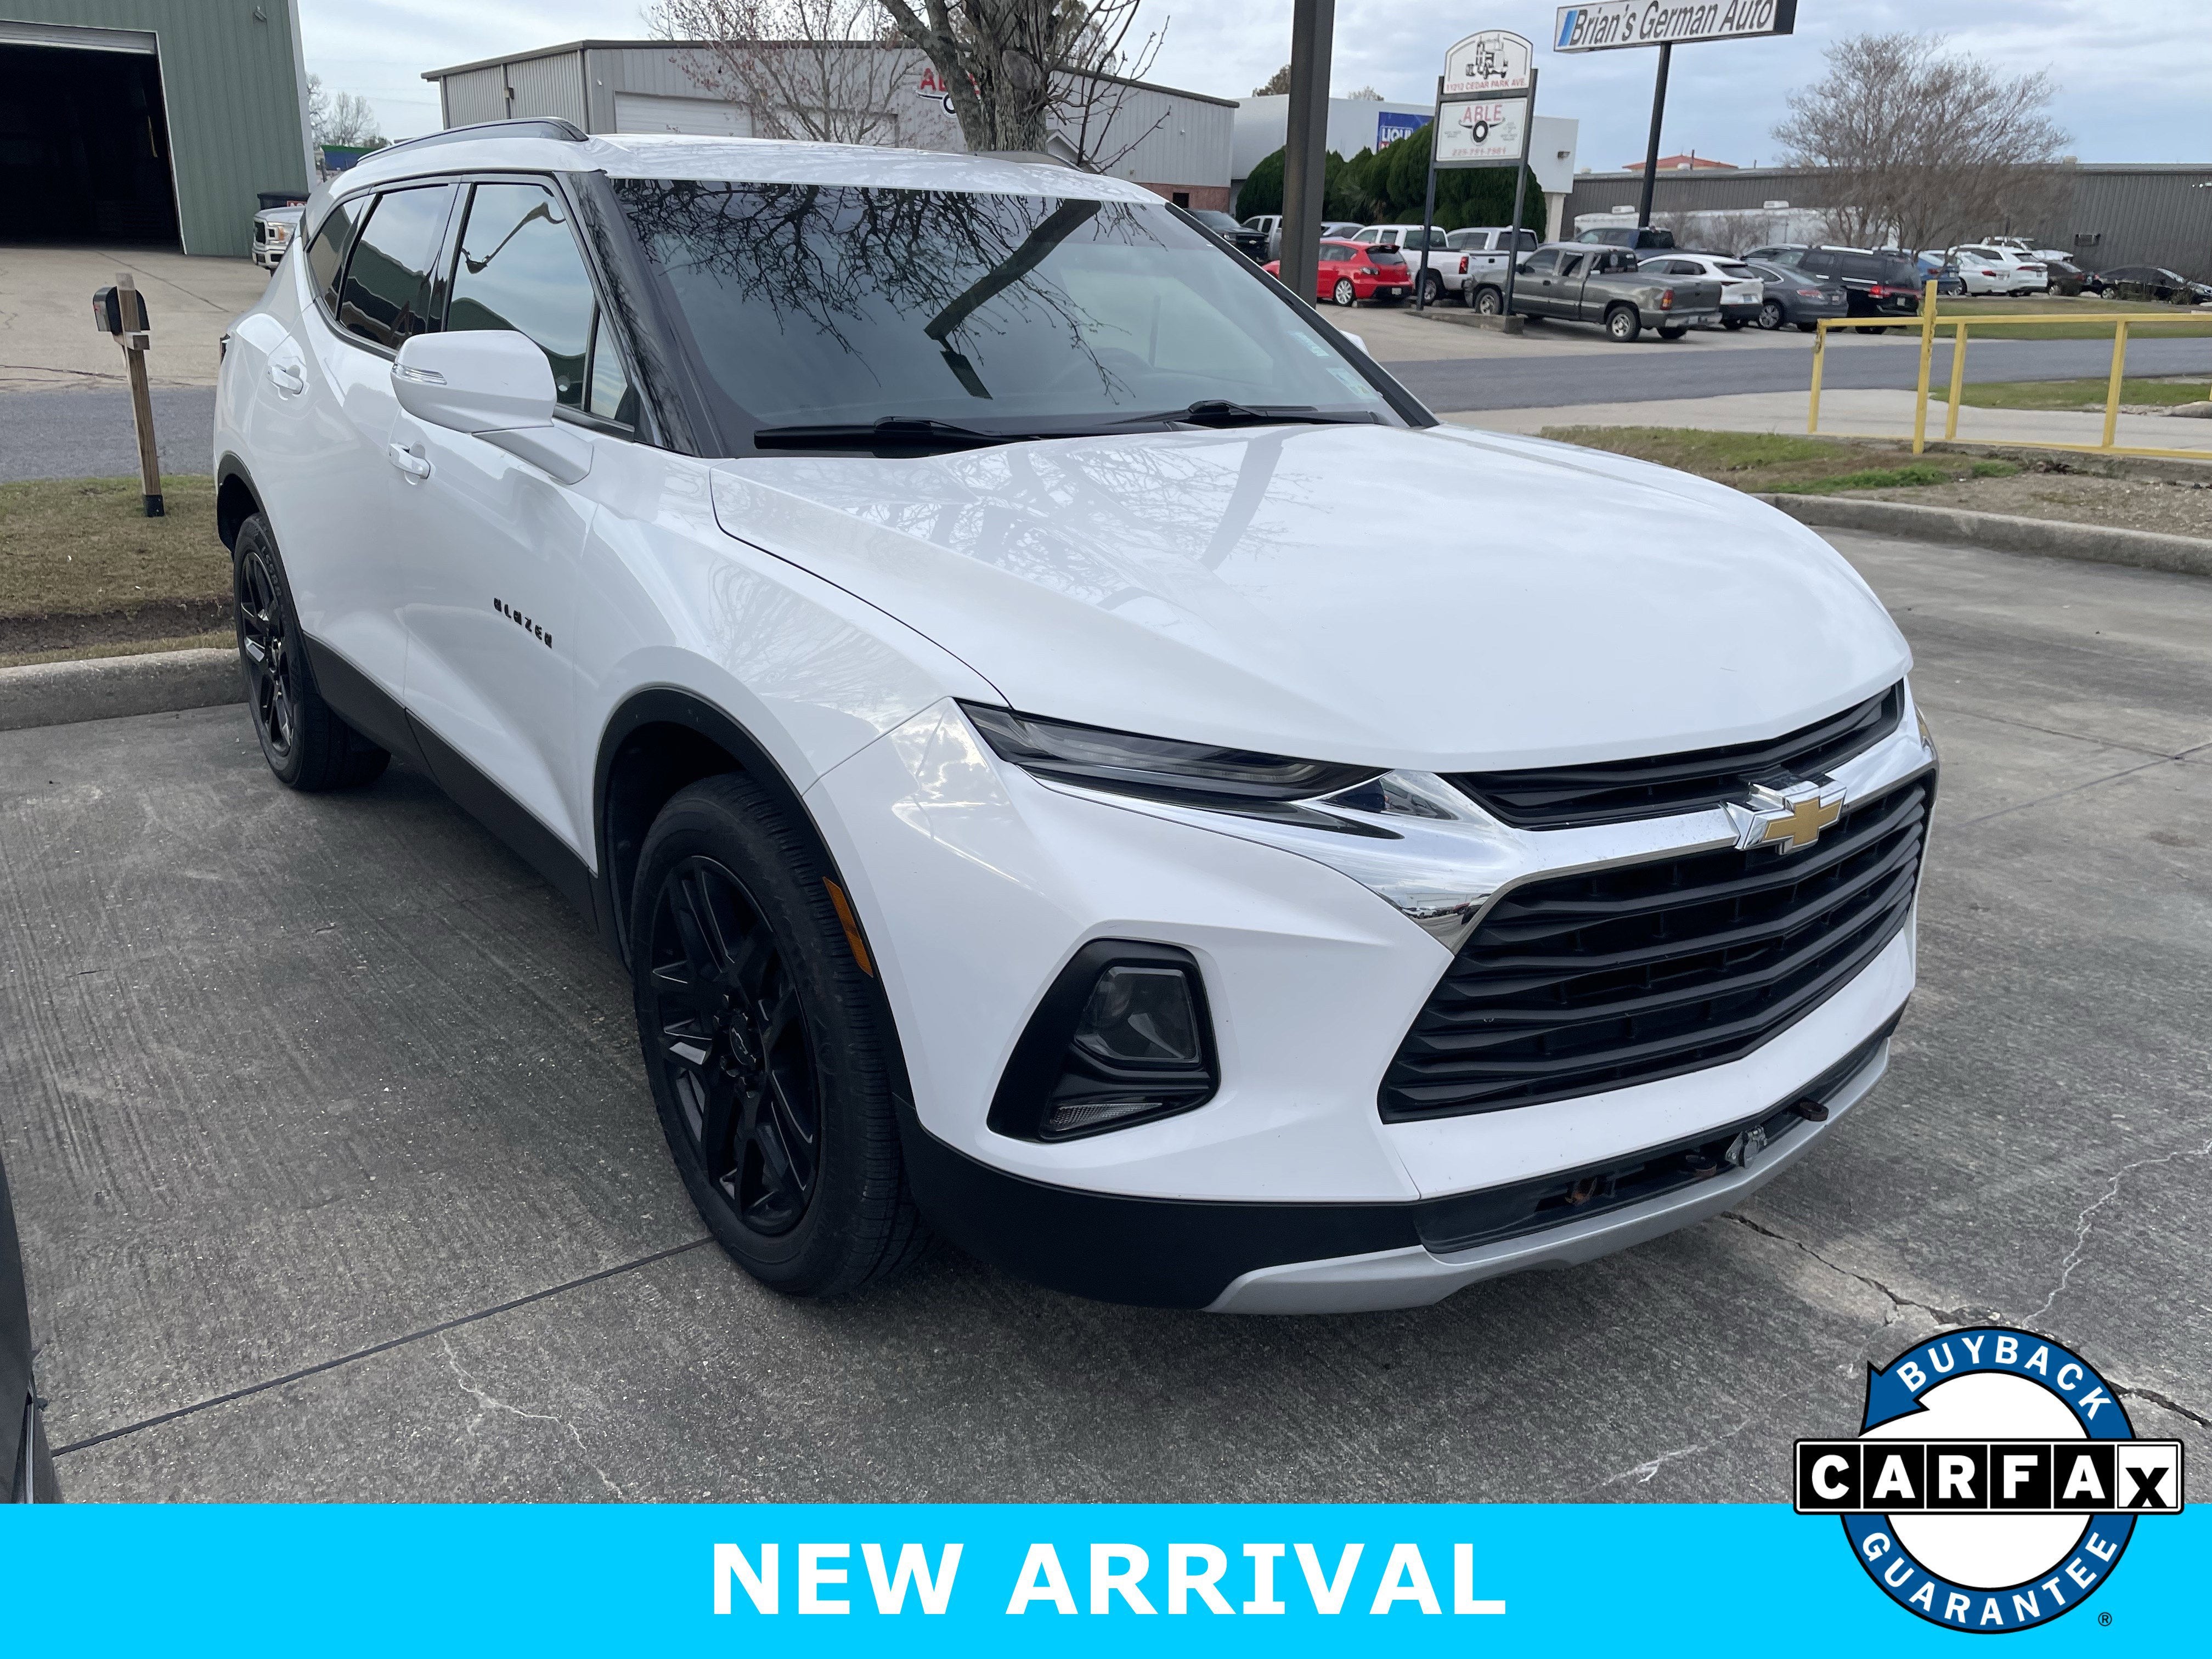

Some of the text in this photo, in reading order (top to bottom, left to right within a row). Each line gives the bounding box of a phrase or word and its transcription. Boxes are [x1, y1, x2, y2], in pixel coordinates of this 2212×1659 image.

[1570, 0, 1773, 46] Brian's German Auto
[1466, 81, 1489, 91] CEDAR
[1491, 80, 1509, 88] PARK
[1464, 104, 1503, 122] ABLE
[494, 597, 552, 649] BLAZER
